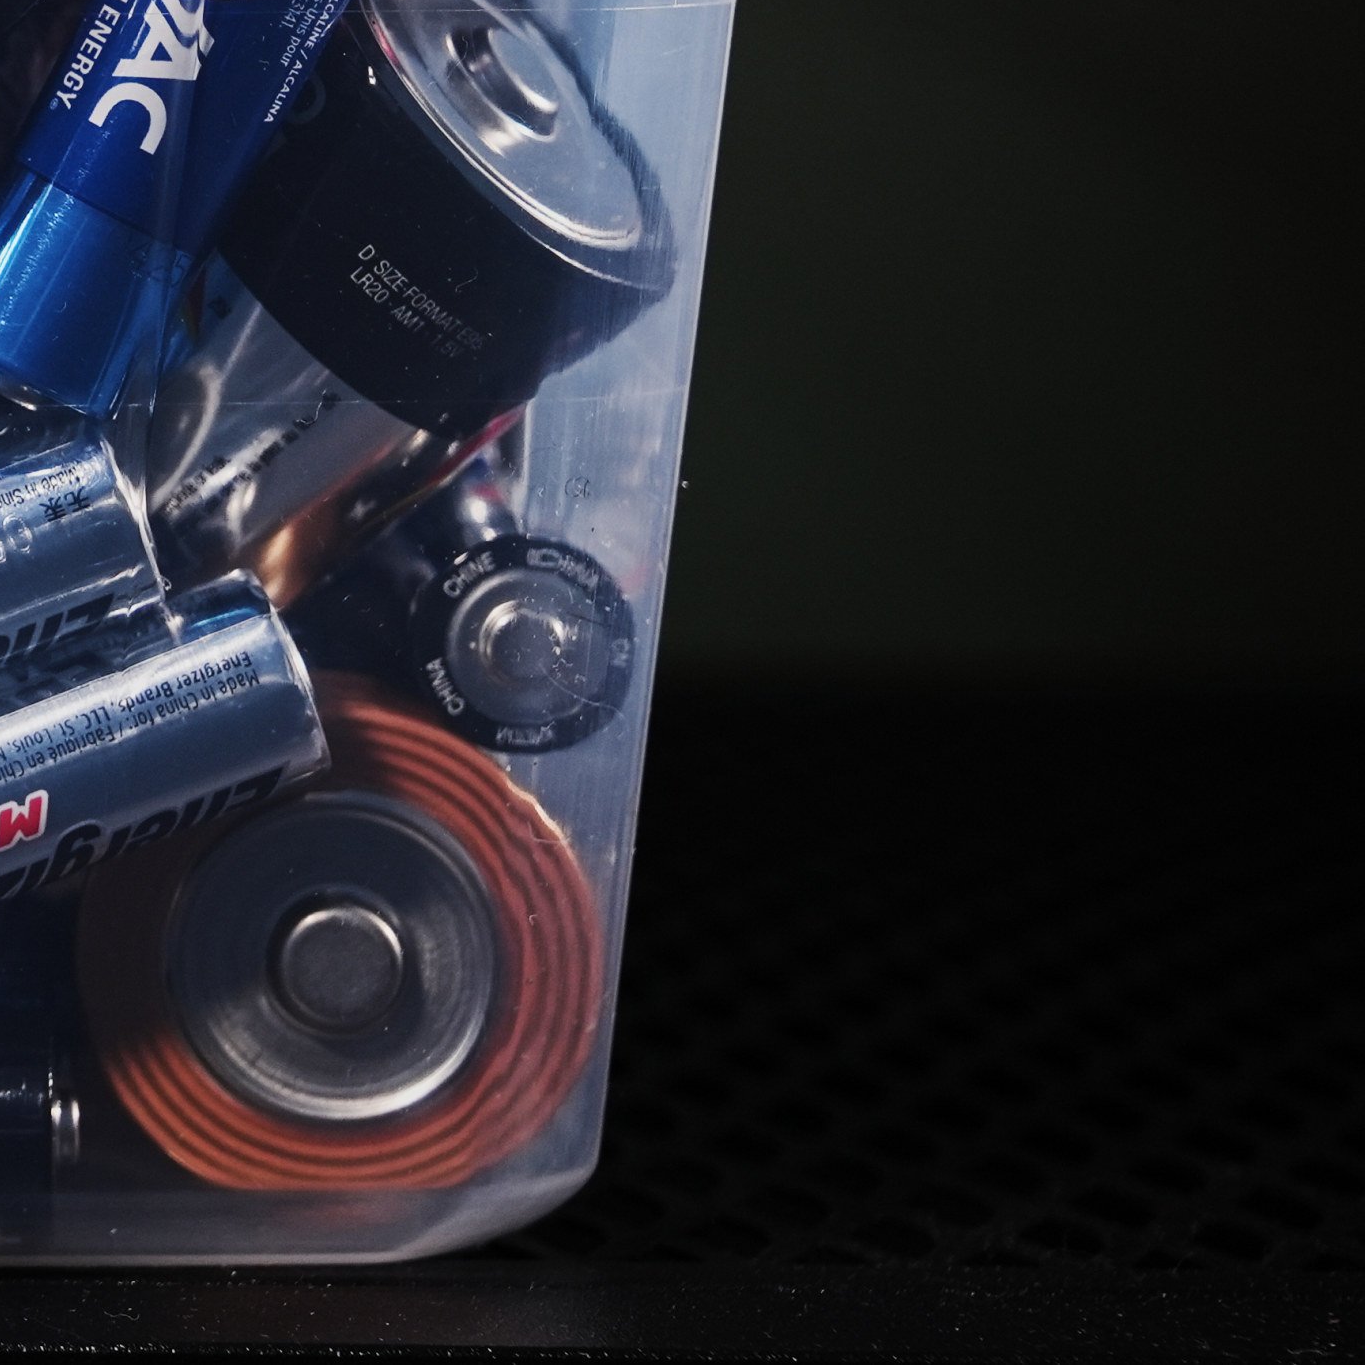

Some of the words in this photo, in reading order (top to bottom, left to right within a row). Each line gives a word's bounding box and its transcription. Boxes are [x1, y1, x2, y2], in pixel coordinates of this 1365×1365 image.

[356, 242, 378, 263] D
[347, 264, 392, 305] LR20
[37, 484, 94, 524] 无汞
[441, 549, 498, 600] CHINE
[424, 654, 466, 717] CHINA
